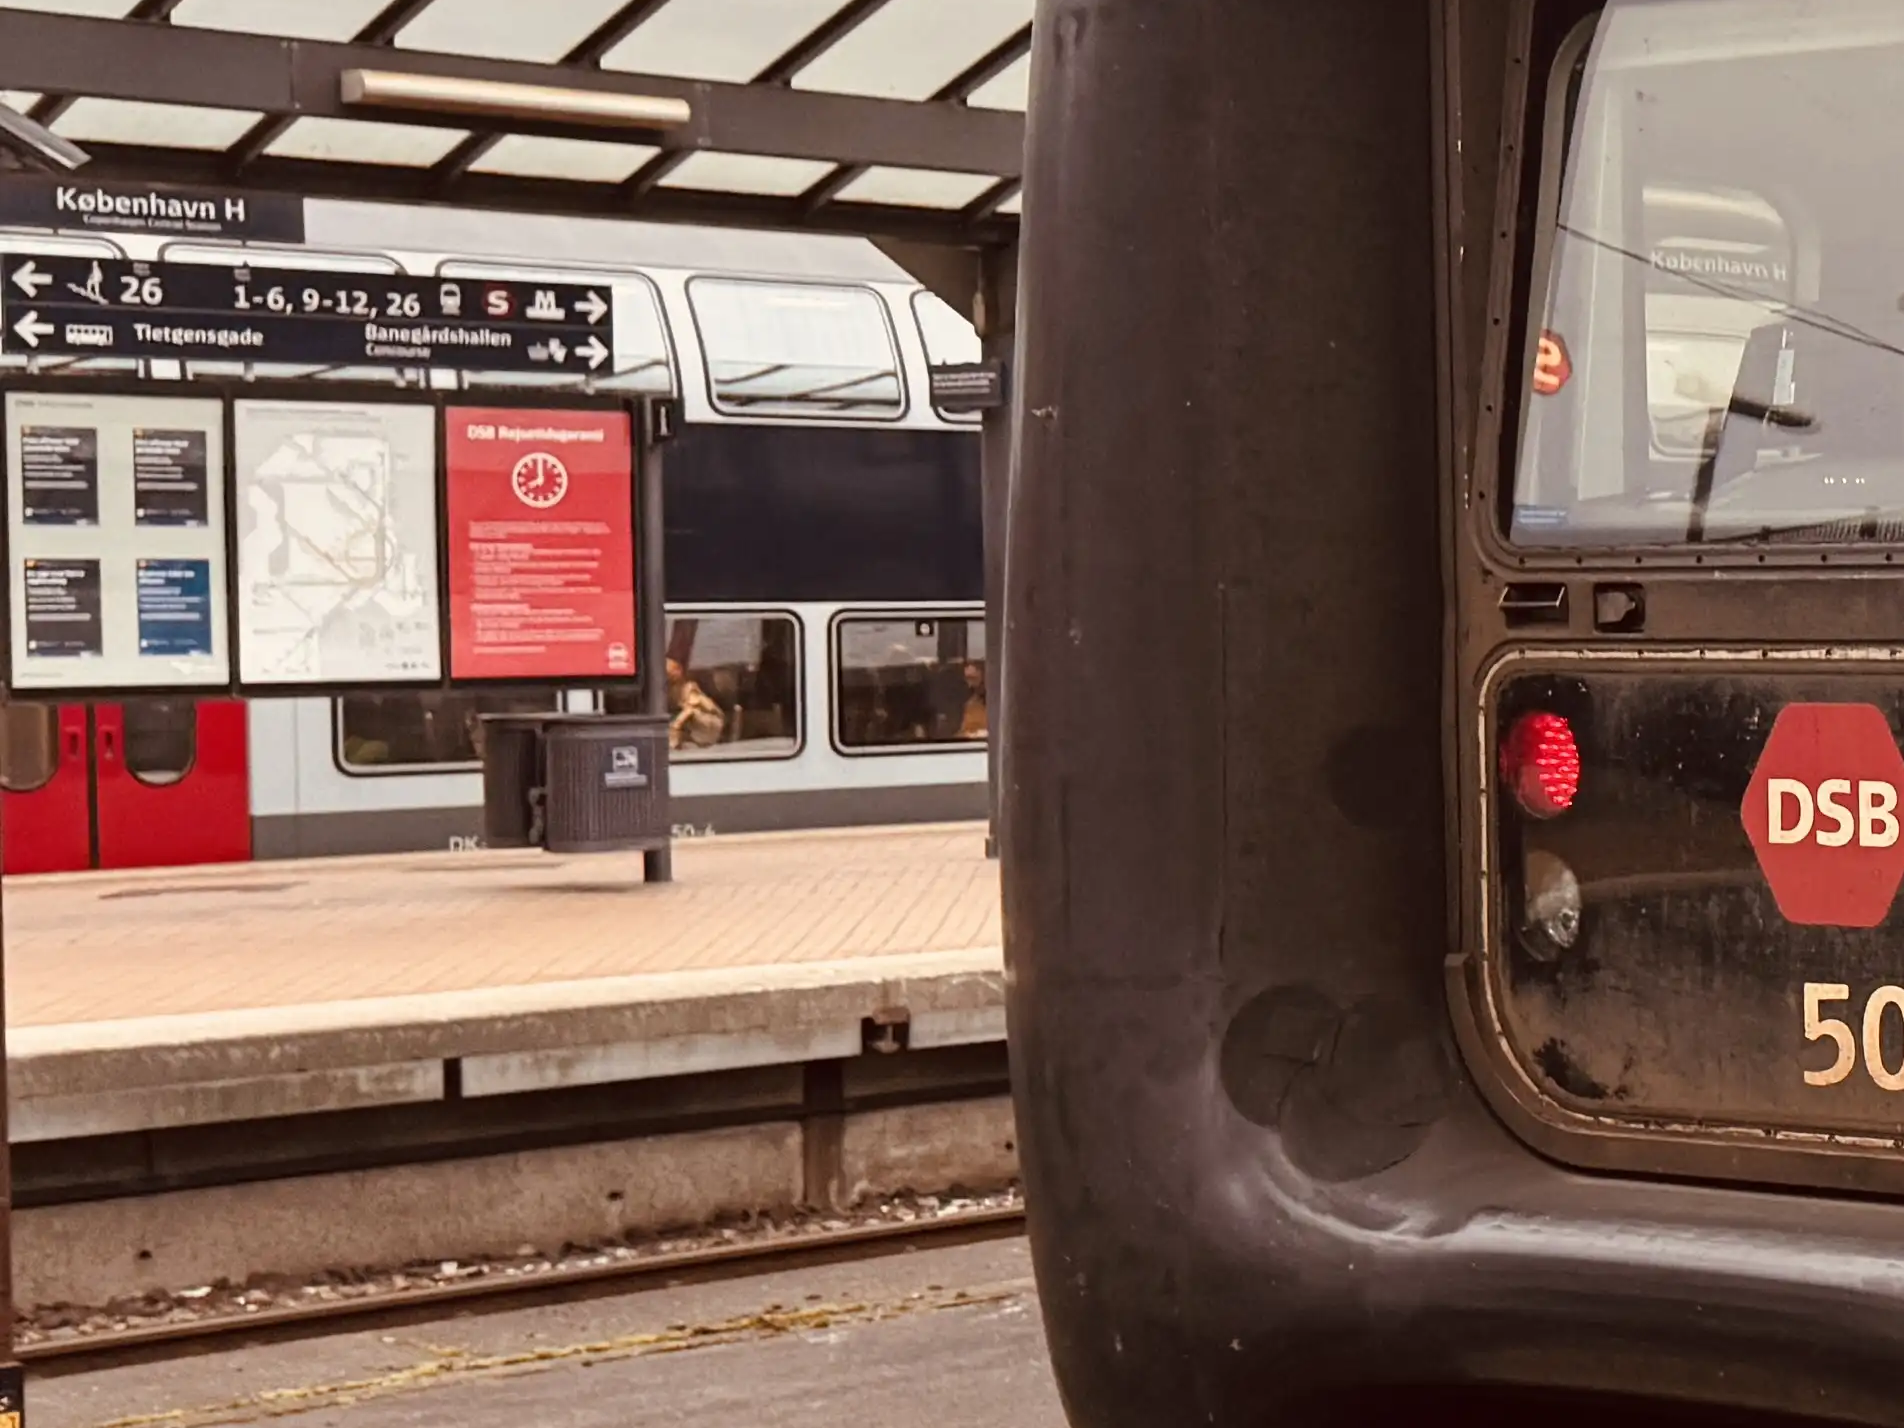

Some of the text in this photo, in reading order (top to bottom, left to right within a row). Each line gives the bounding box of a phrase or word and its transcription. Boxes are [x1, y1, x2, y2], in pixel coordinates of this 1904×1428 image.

[56, 185, 246, 222] København H
[120, 275, 163, 306] 26
[233, 284, 422, 320] 1-6, 9-12, 26
[132, 323, 264, 348] Tietgensgade
[365, 322, 512, 348] Banegårdshallen
[1767, 778, 1900, 848] DSB
